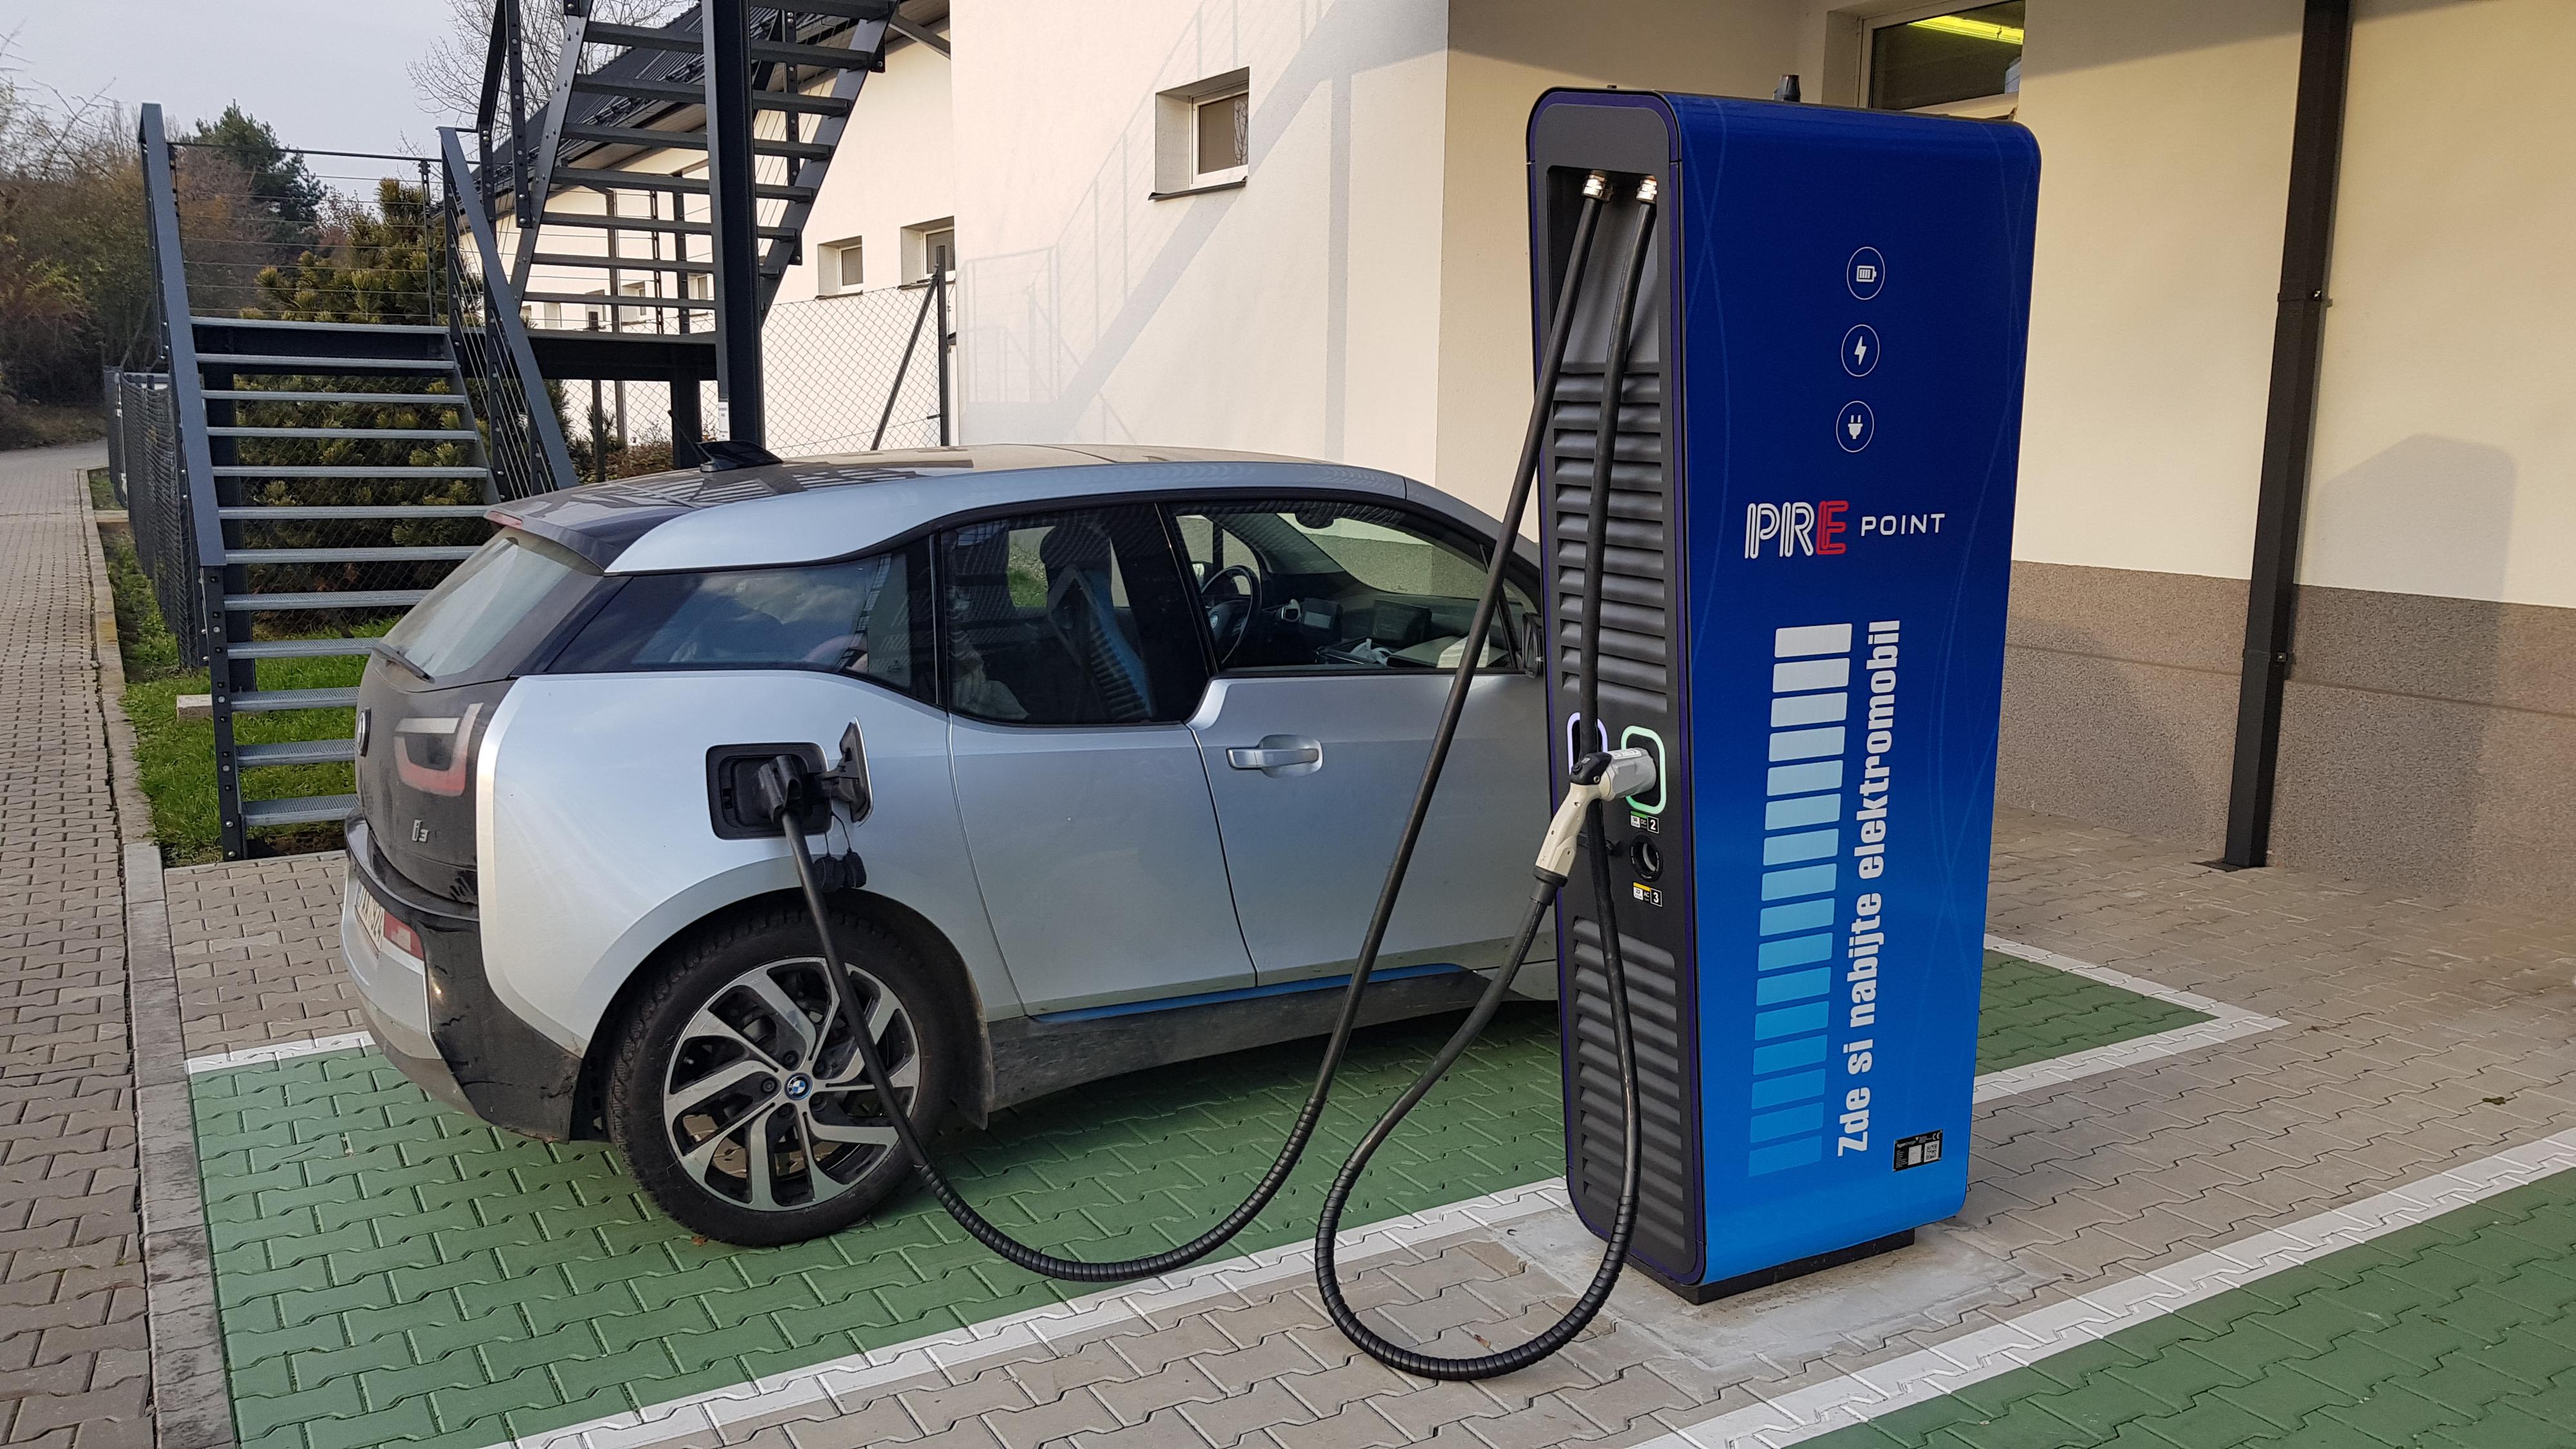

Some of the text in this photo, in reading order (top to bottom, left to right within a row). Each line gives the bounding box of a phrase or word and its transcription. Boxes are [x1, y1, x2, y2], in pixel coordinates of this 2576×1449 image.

[1744, 500, 1946, 559] PRE POINT
[412, 819, 430, 842] i3
[1650, 819, 1656, 831] 2
[1653, 891, 1660, 904] 3
[1837, 620, 1900, 1157] Zde si nabijte elektromobil
